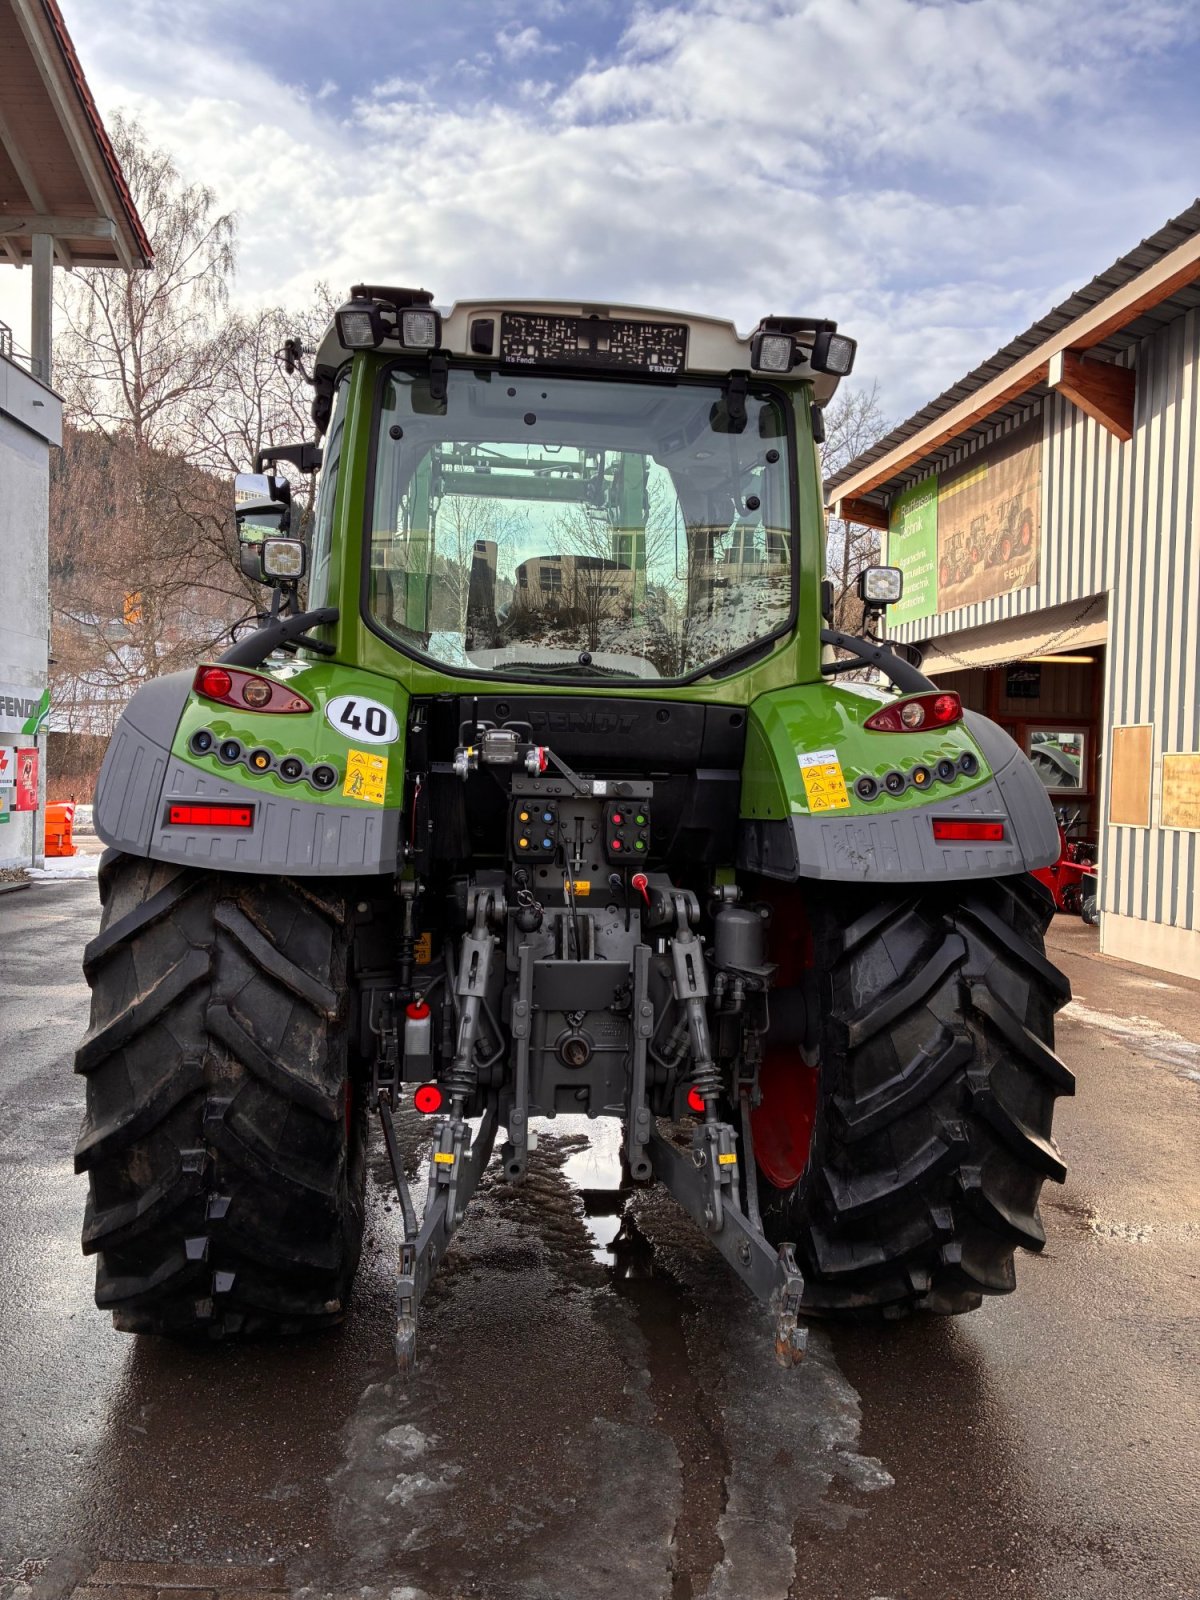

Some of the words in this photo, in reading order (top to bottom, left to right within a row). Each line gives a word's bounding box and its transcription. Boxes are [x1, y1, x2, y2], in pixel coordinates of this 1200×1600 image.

[649, 365, 679, 373] FENDT
[1003, 564, 1031, 581] FENDT
[340, 701, 387, 736] 40
[528, 711, 639, 734] FENDT
